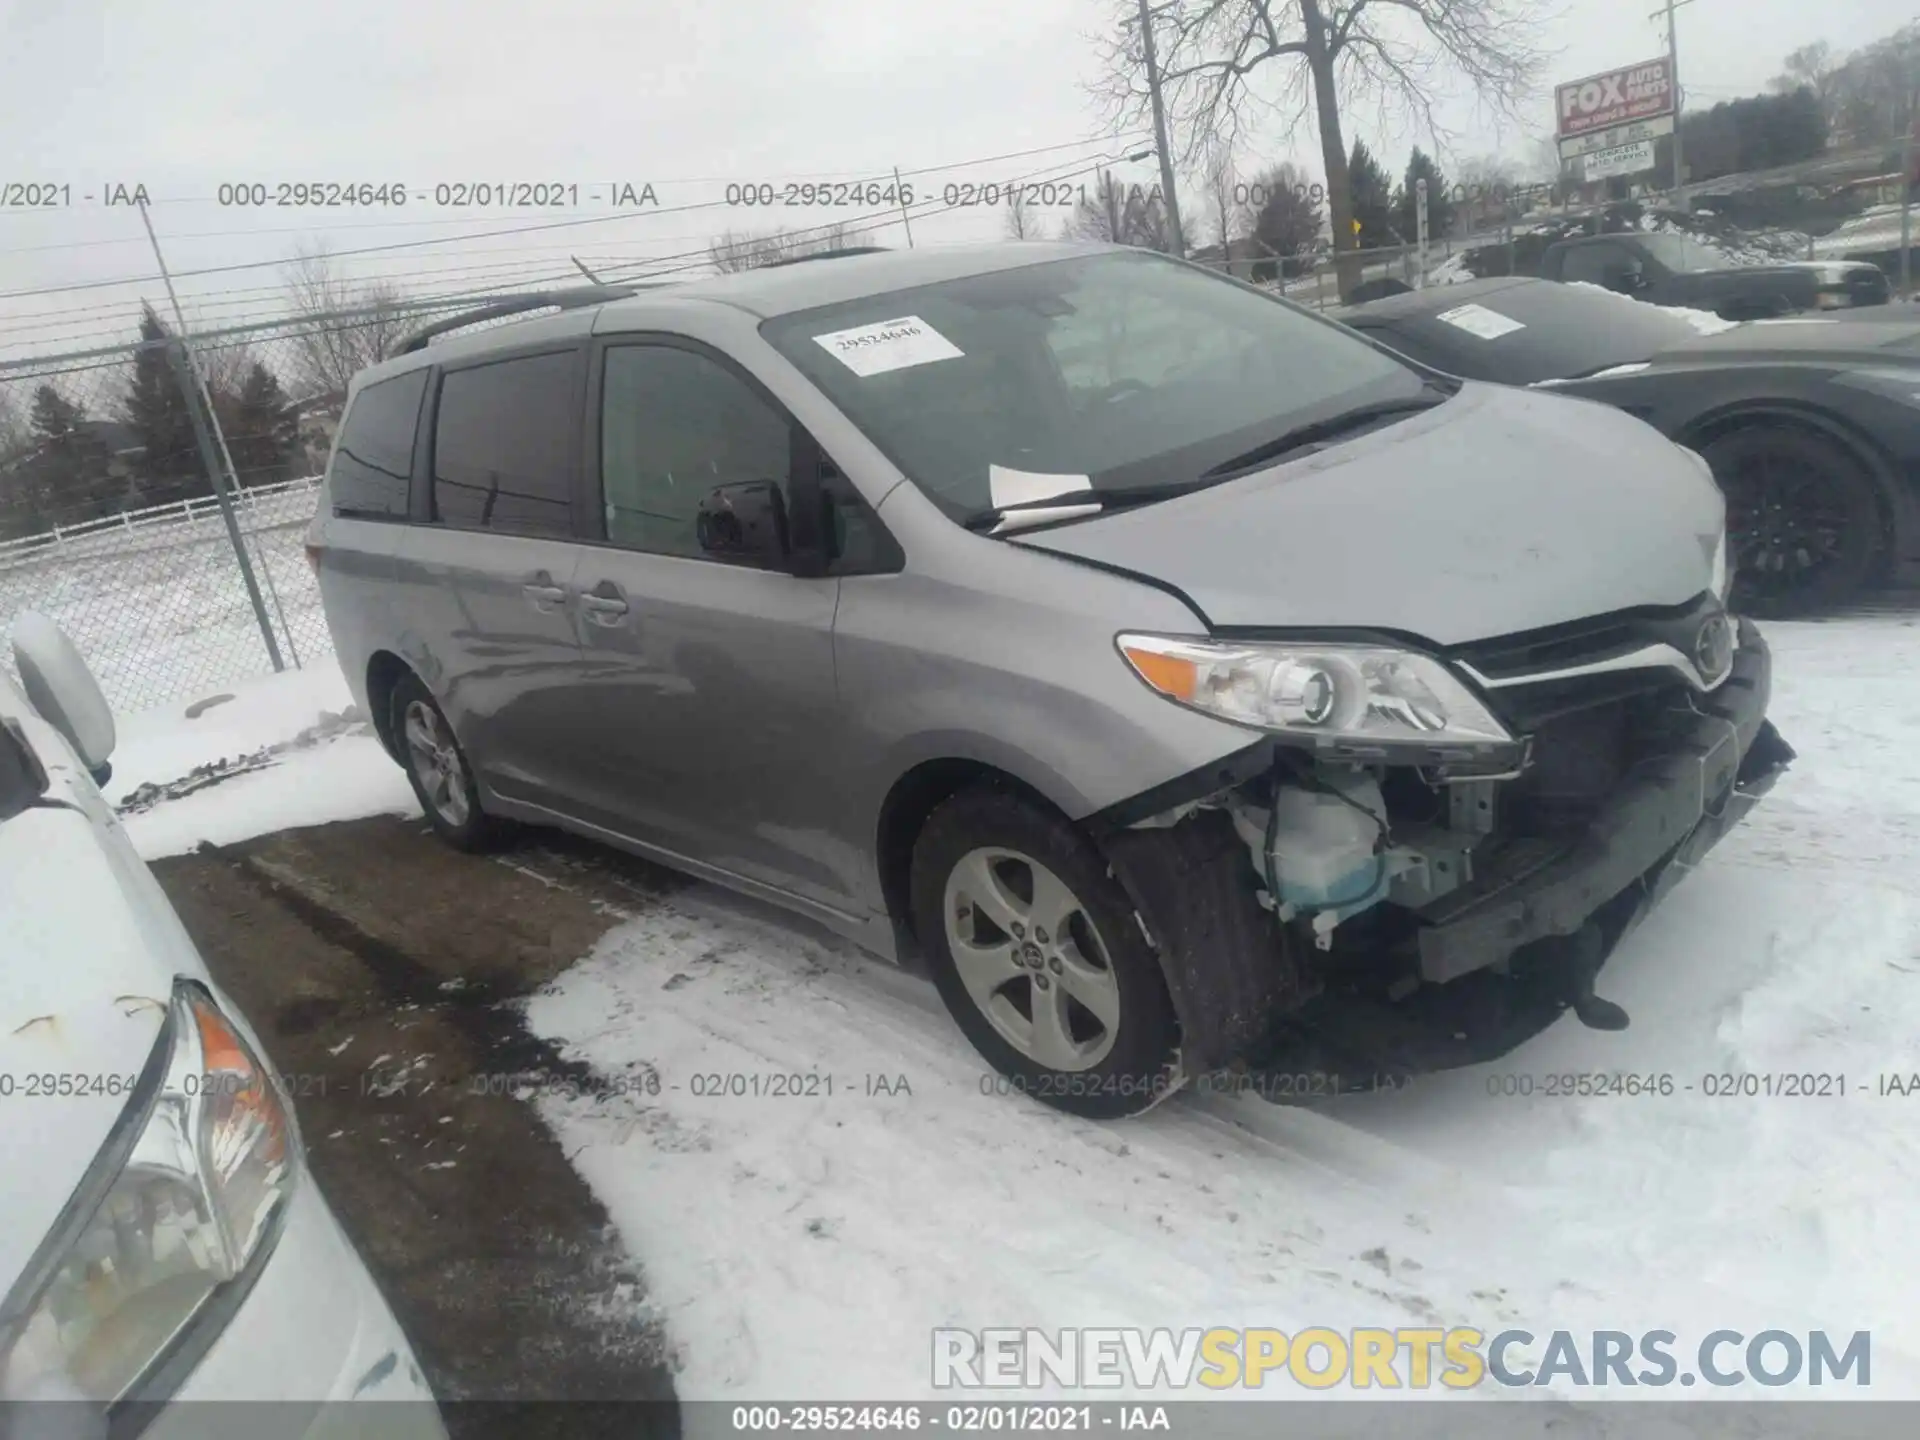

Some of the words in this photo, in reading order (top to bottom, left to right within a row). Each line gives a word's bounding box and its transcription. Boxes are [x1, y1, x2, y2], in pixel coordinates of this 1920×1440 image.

[1626, 65, 1664, 87] AUTO
[1562, 75, 1625, 118] FOX
[1627, 80, 1669, 101] PARTS
[835, 327, 921, 350] 29524646
